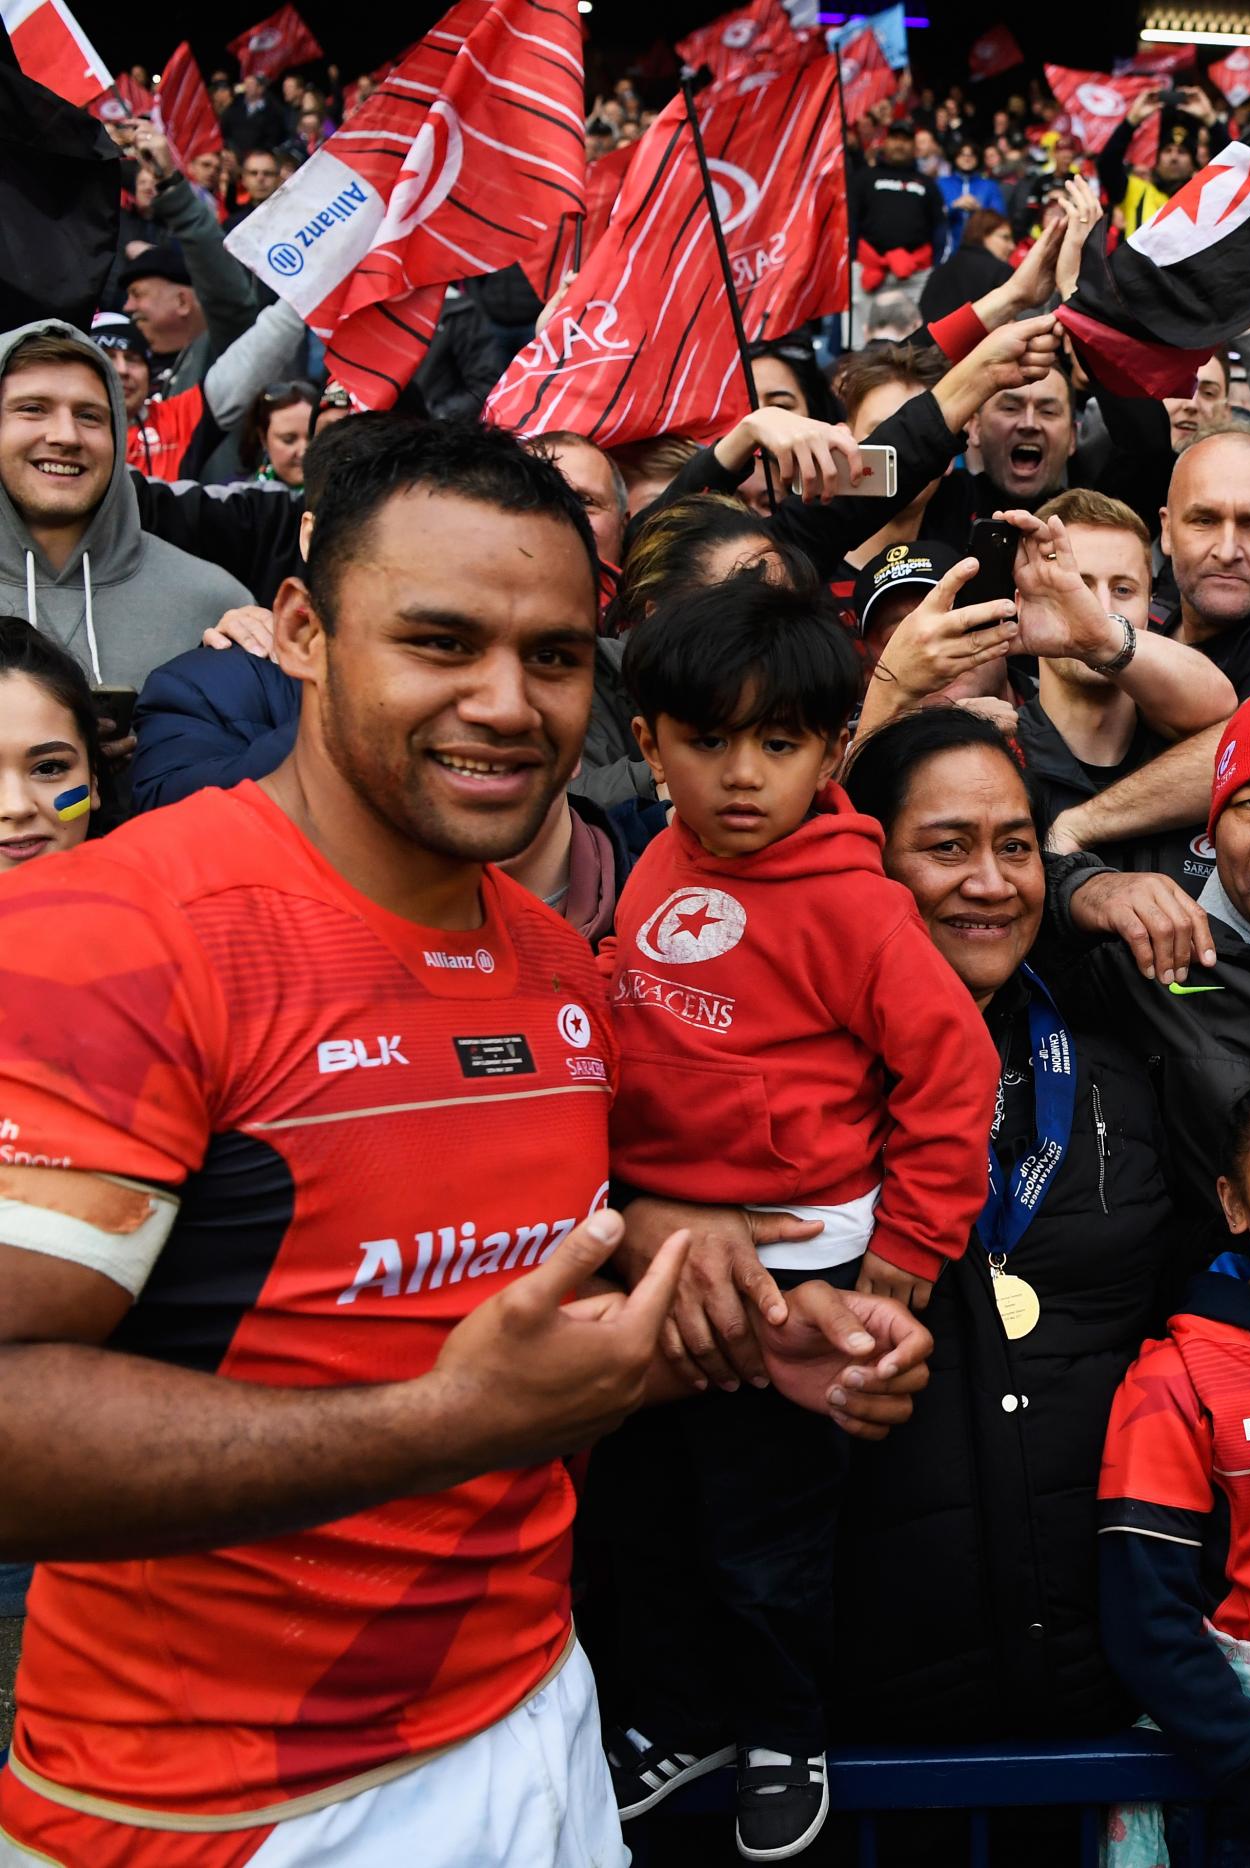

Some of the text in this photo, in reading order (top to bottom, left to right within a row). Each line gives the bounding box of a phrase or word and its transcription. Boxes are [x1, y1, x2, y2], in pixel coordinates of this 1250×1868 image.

[295, 181, 368, 248] Allianz
[874, 561, 933, 584] CHAMPIONS
[891, 569, 912, 579] CUP
[422, 950, 475, 969] Allianz
[317, 1035, 410, 1073] BLK
[1020, 1155, 1037, 1178] CUP
[1020, 1141, 1057, 1205] CHAMPIONS
[1027, 1145, 1063, 1211] EUROPEAN RUGBY
[335, 1216, 577, 1306] Allianz
